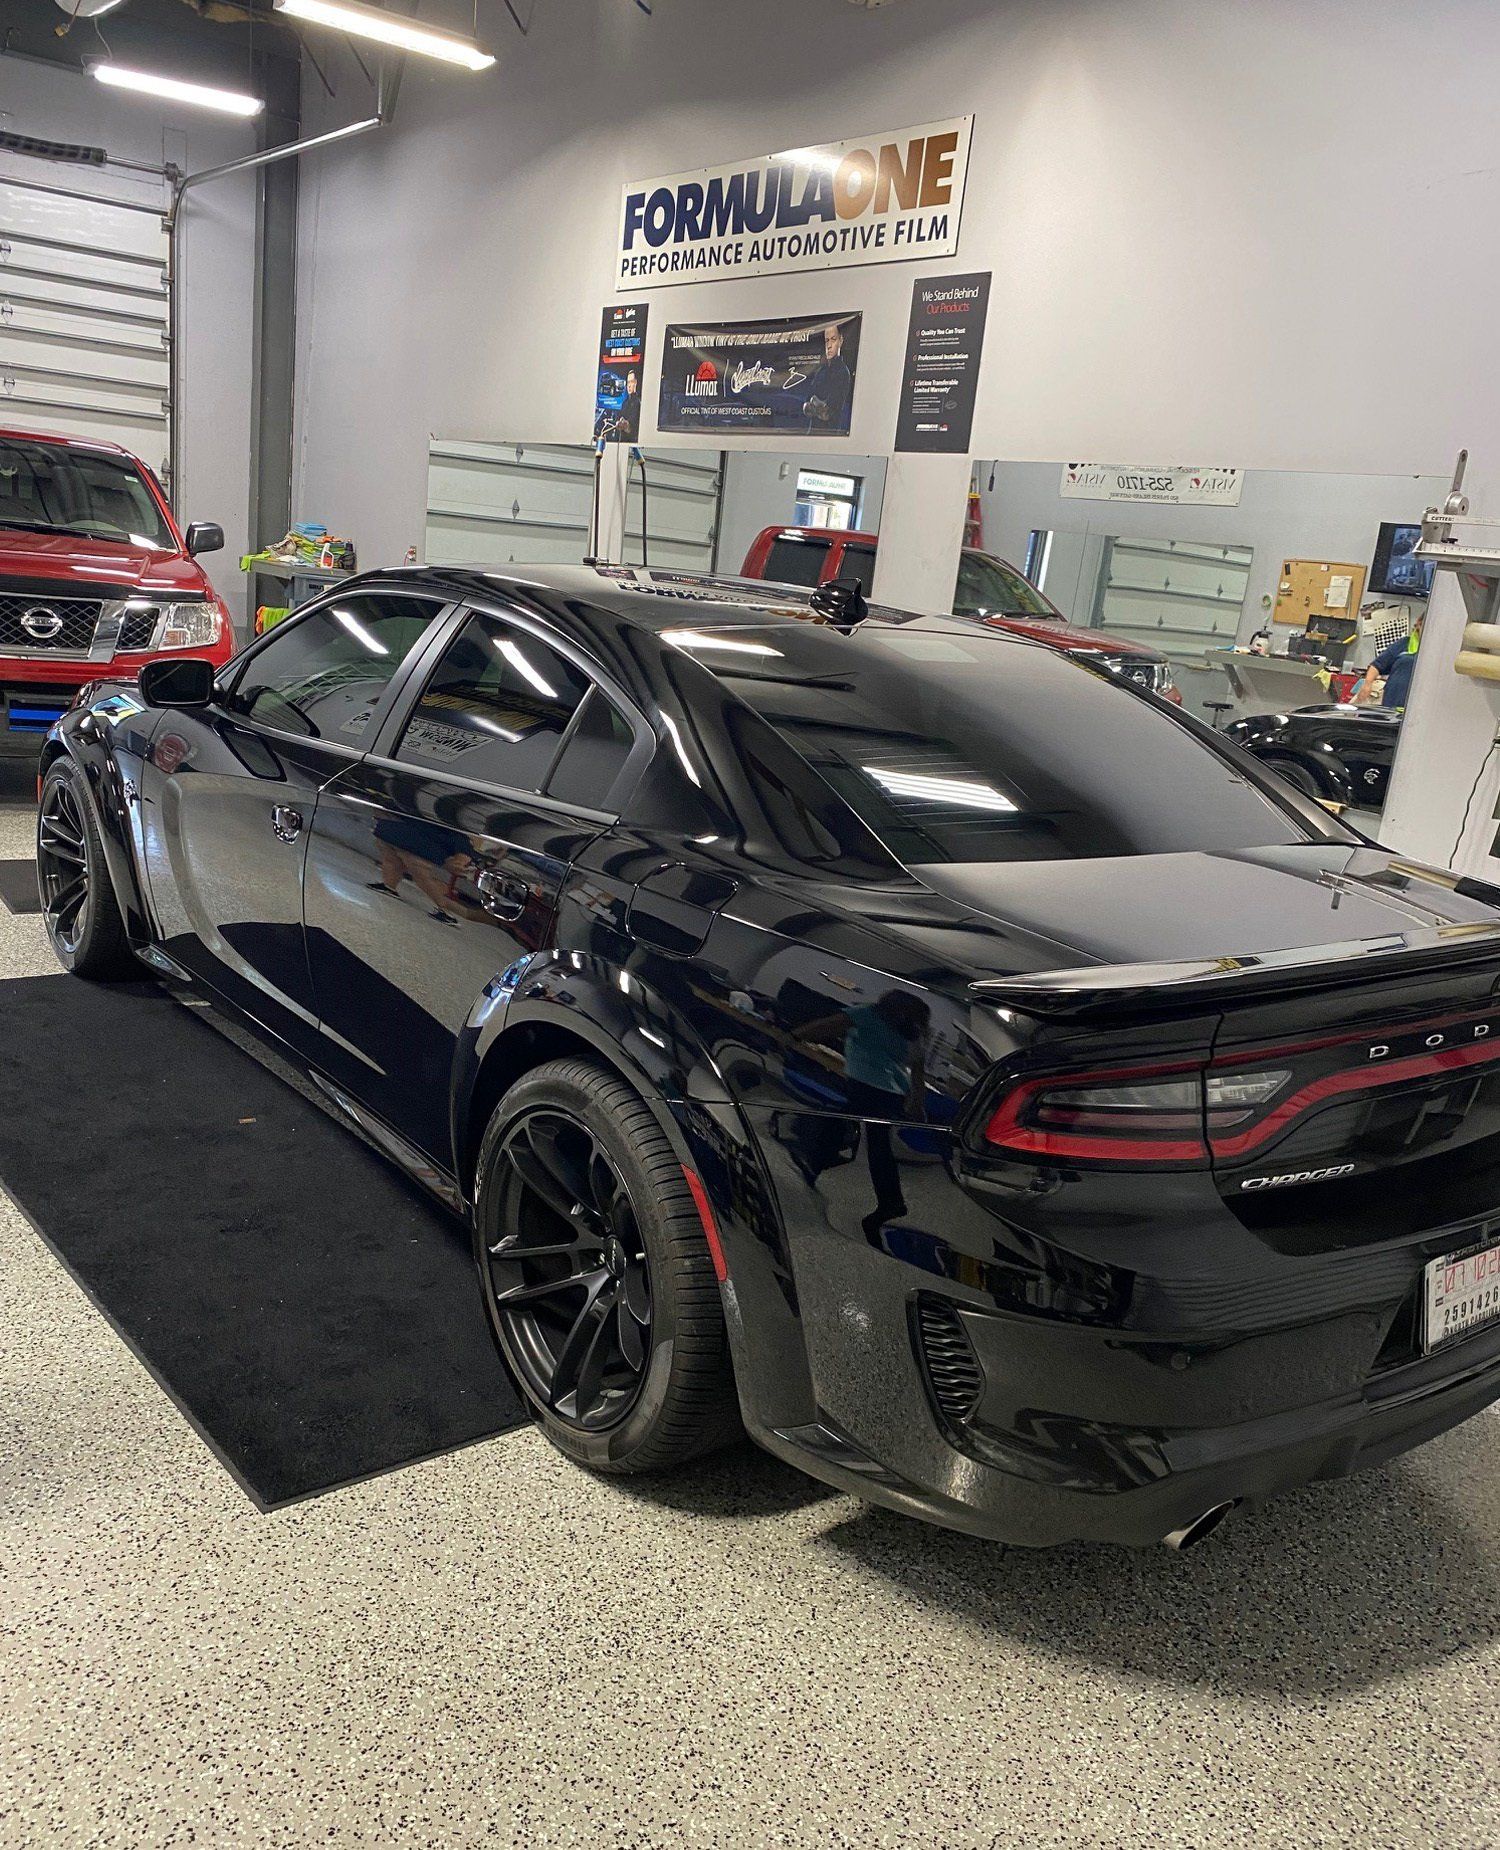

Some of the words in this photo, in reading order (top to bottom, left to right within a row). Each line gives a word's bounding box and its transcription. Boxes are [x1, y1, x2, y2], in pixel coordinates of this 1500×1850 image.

[621, 242, 742, 277] PERFORMANCE
[748, 222, 887, 262] AUTOMOTIVE
[894, 214, 948, 244] FILM
[922, 290, 934, 301] We
[934, 288, 954, 301] Stand
[954, 286, 979, 299] Behind
[927, 303, 940, 314] Our
[940, 301, 970, 313] Products
[681, 407, 700, 415] OFFICIAL
[718, 407, 731, 415] WEST
[731, 407, 748, 415] COAST
[748, 407, 771, 415] CUSTOMS
[1240, 1163, 1355, 1190] CHARGER
